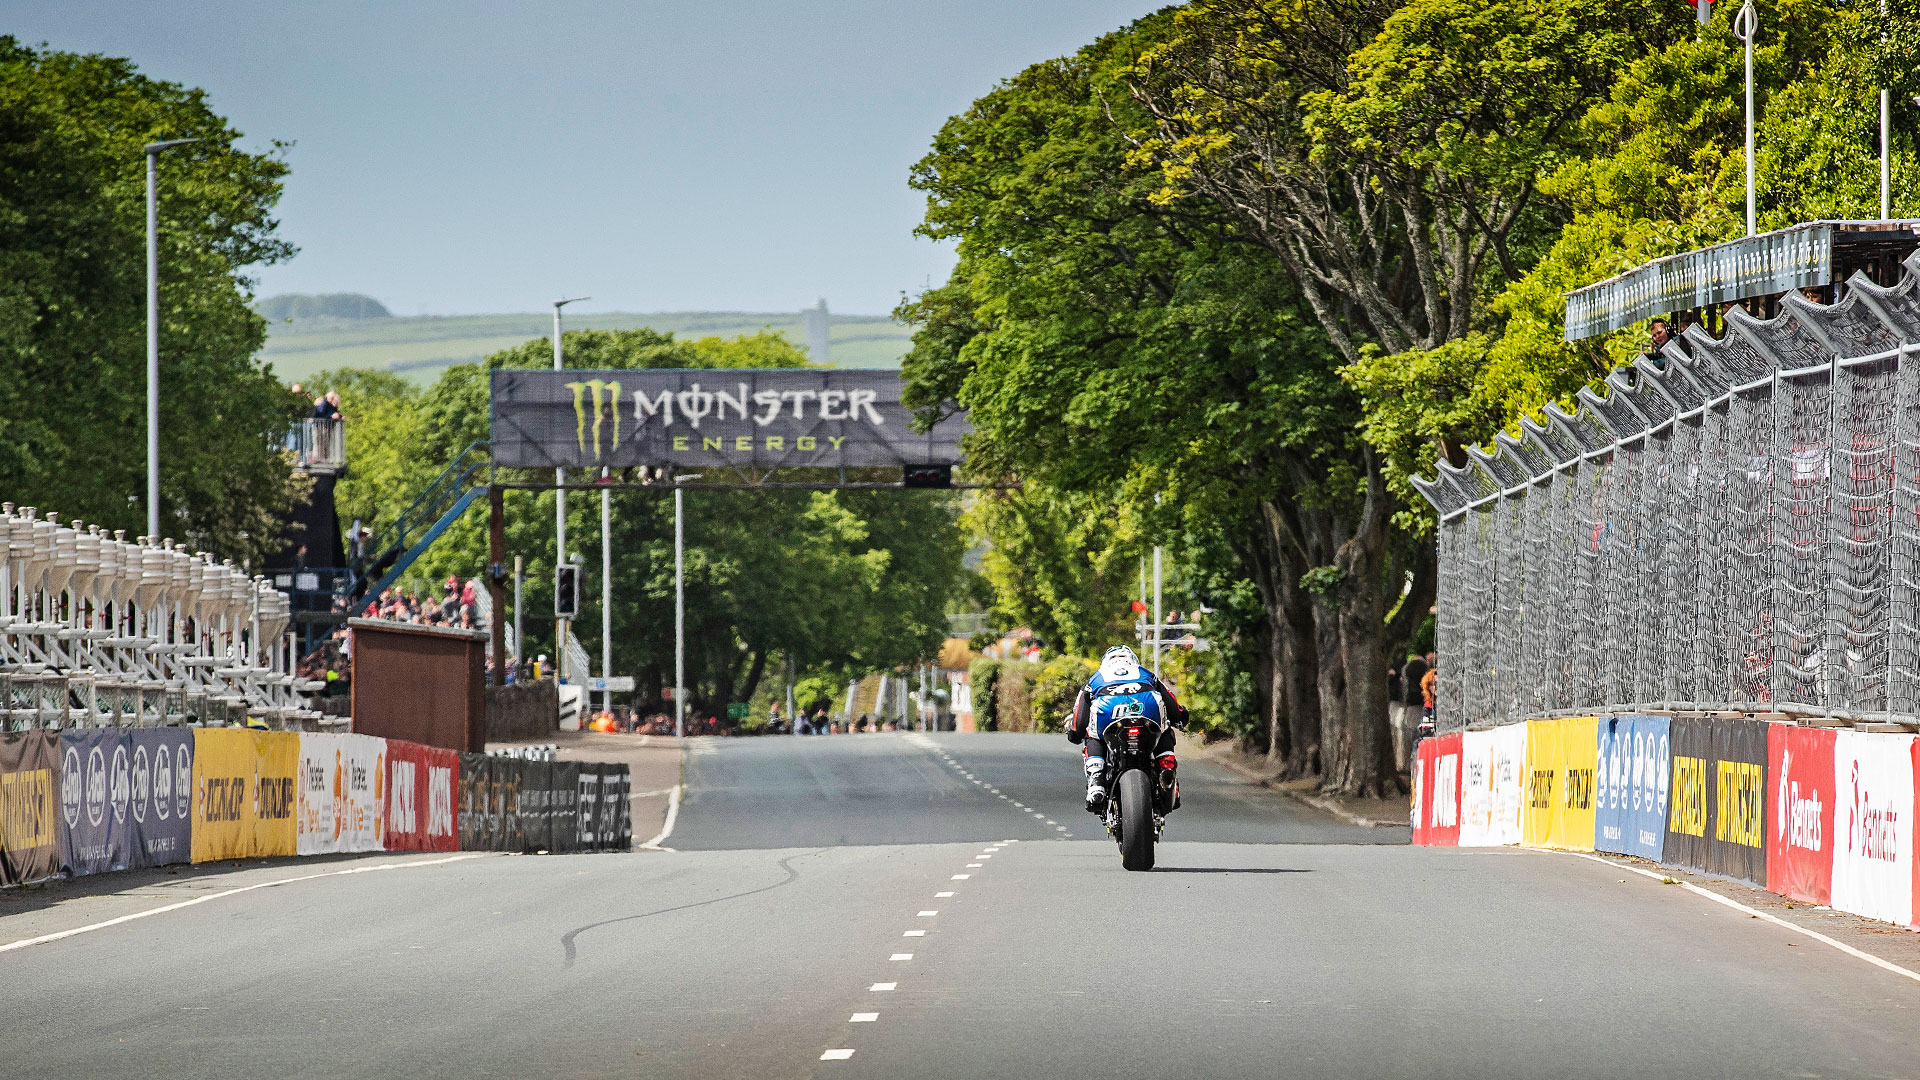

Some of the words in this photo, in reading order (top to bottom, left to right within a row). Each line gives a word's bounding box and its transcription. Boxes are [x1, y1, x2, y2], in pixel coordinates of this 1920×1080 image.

[632, 382, 885, 428] MONSTER
[673, 435, 847, 452] ENERGY
[206, 777, 245, 822] DUNLOP
[1862, 790, 1898, 863] Bennetts
